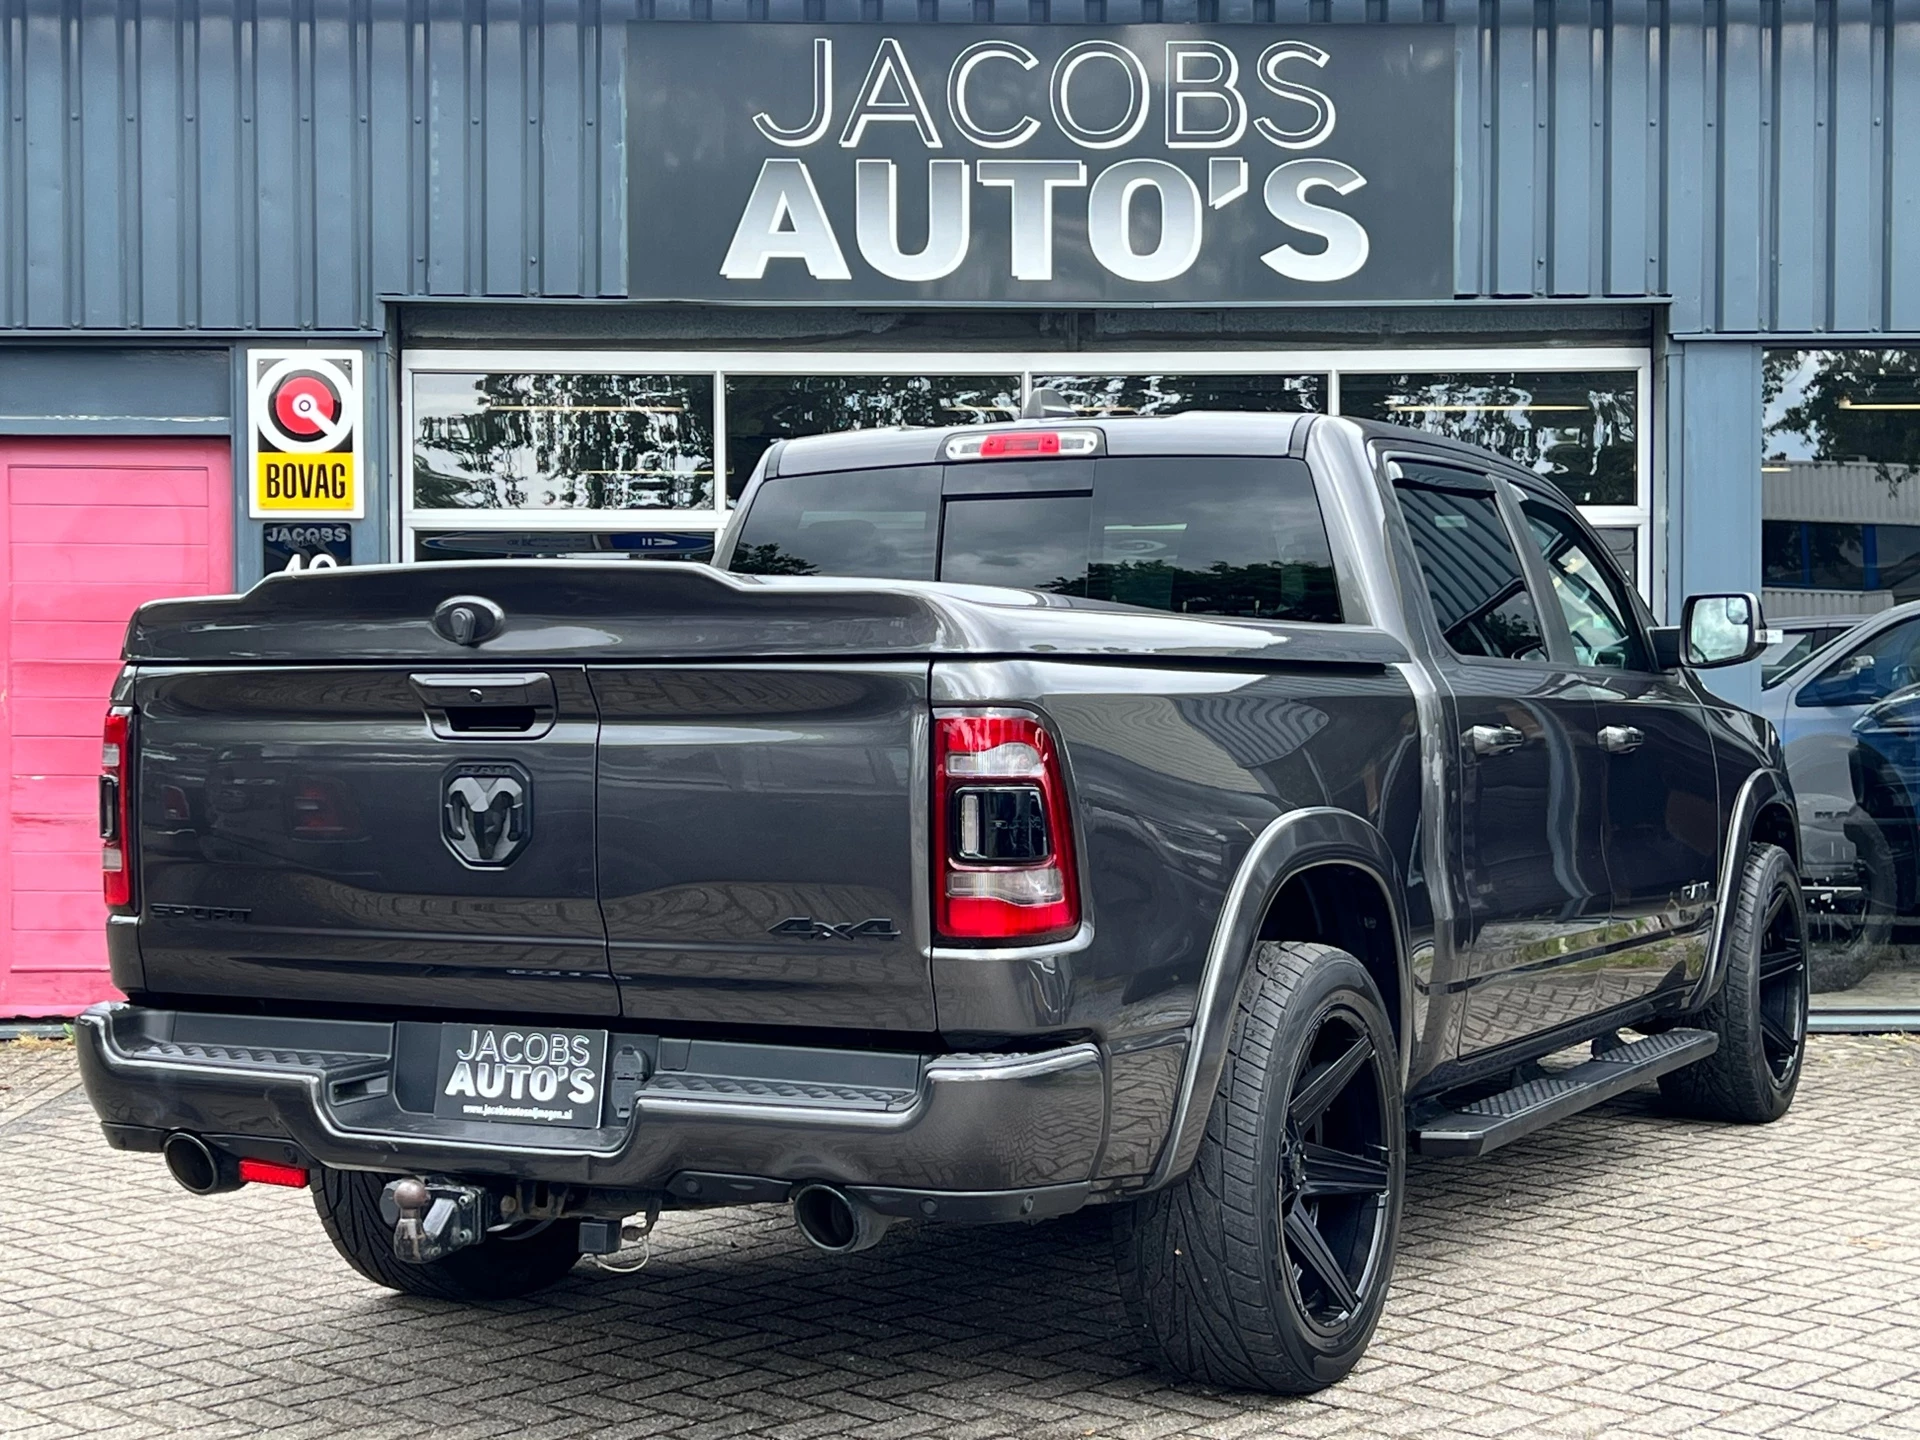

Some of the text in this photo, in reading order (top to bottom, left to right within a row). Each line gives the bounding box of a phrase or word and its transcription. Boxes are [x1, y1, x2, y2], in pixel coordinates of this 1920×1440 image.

[752, 38, 1336, 149] JACOBS
[719, 158, 1370, 282] AUTO'S
[265, 463, 346, 499] BOVAG
[266, 527, 347, 542] JACOBS
[459, 765, 511, 775] RAM
[456, 1029, 590, 1067] JACOBS
[444, 1061, 595, 1104] AUTO'S
